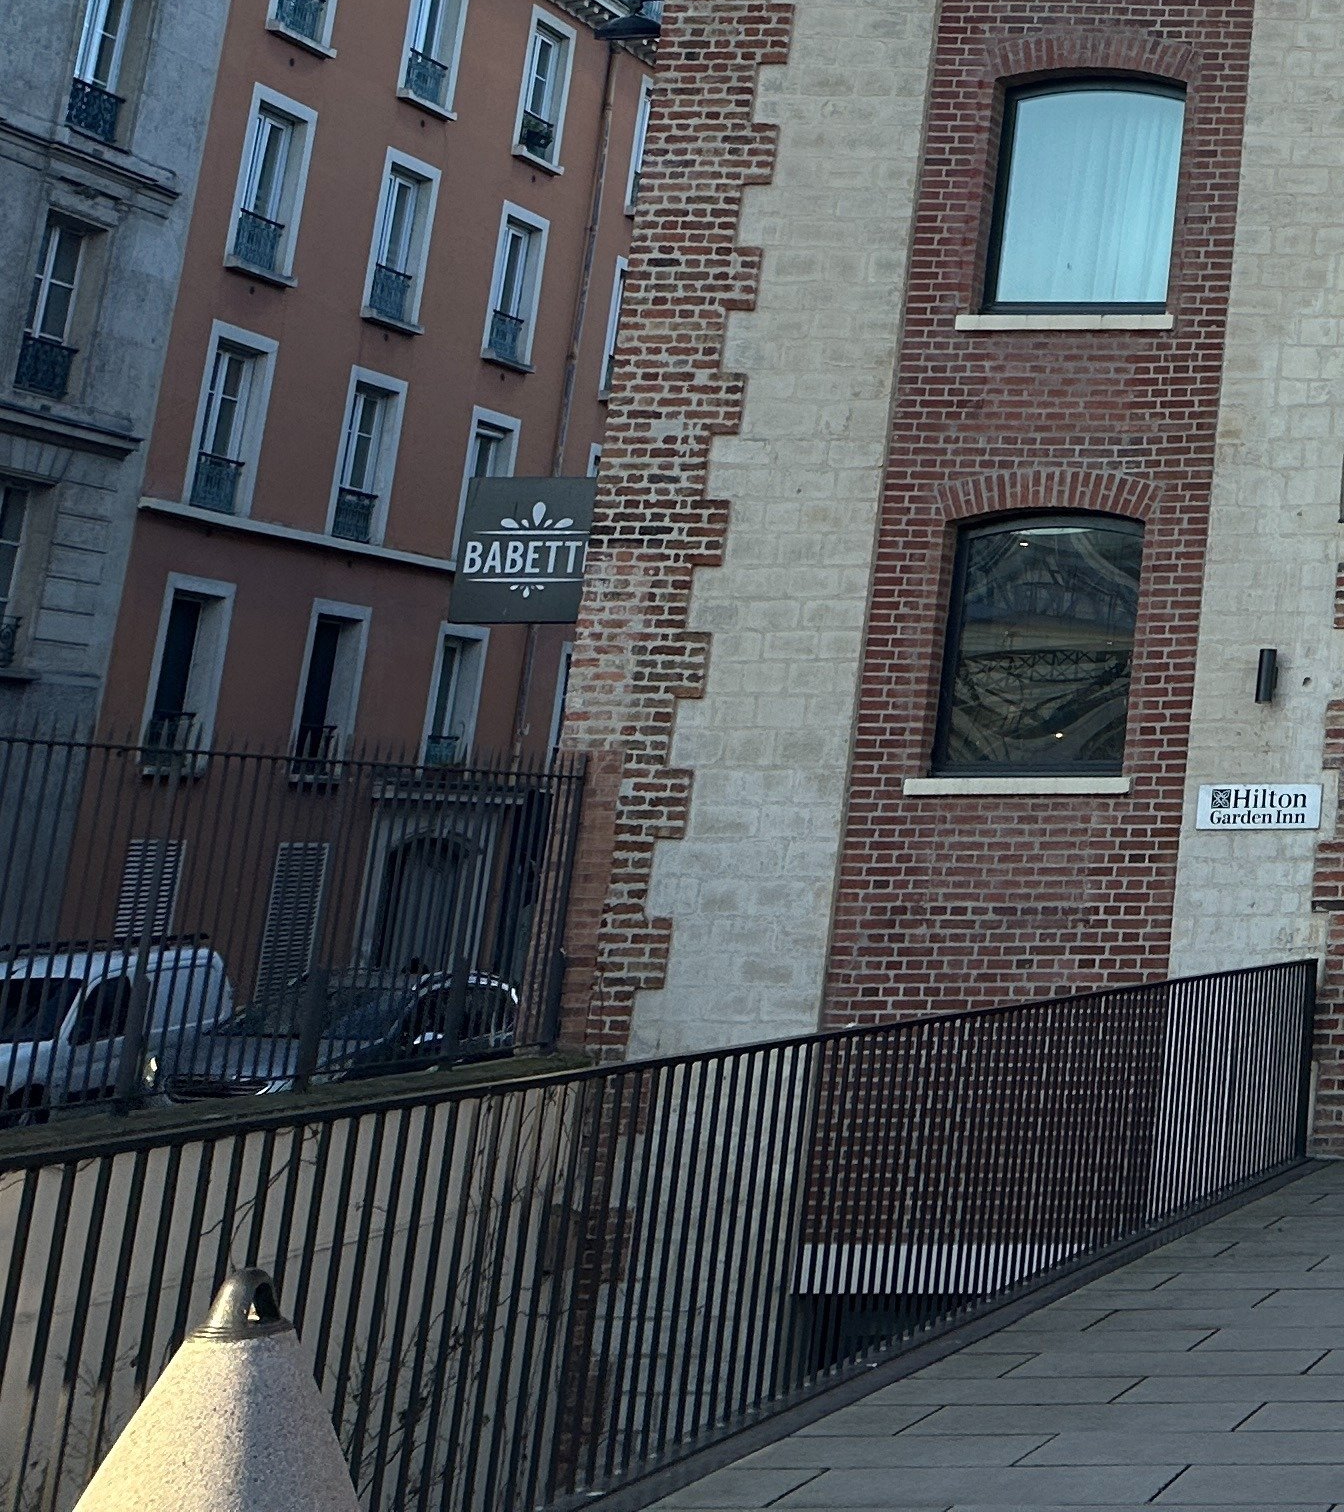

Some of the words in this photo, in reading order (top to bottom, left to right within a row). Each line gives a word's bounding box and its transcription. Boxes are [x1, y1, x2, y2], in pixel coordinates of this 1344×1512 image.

[462, 540, 590, 575] BABETT
[1232, 788, 1308, 809] Hilton
[1210, 809, 1273, 825] Garden
[1275, 809, 1306, 824] Inn
